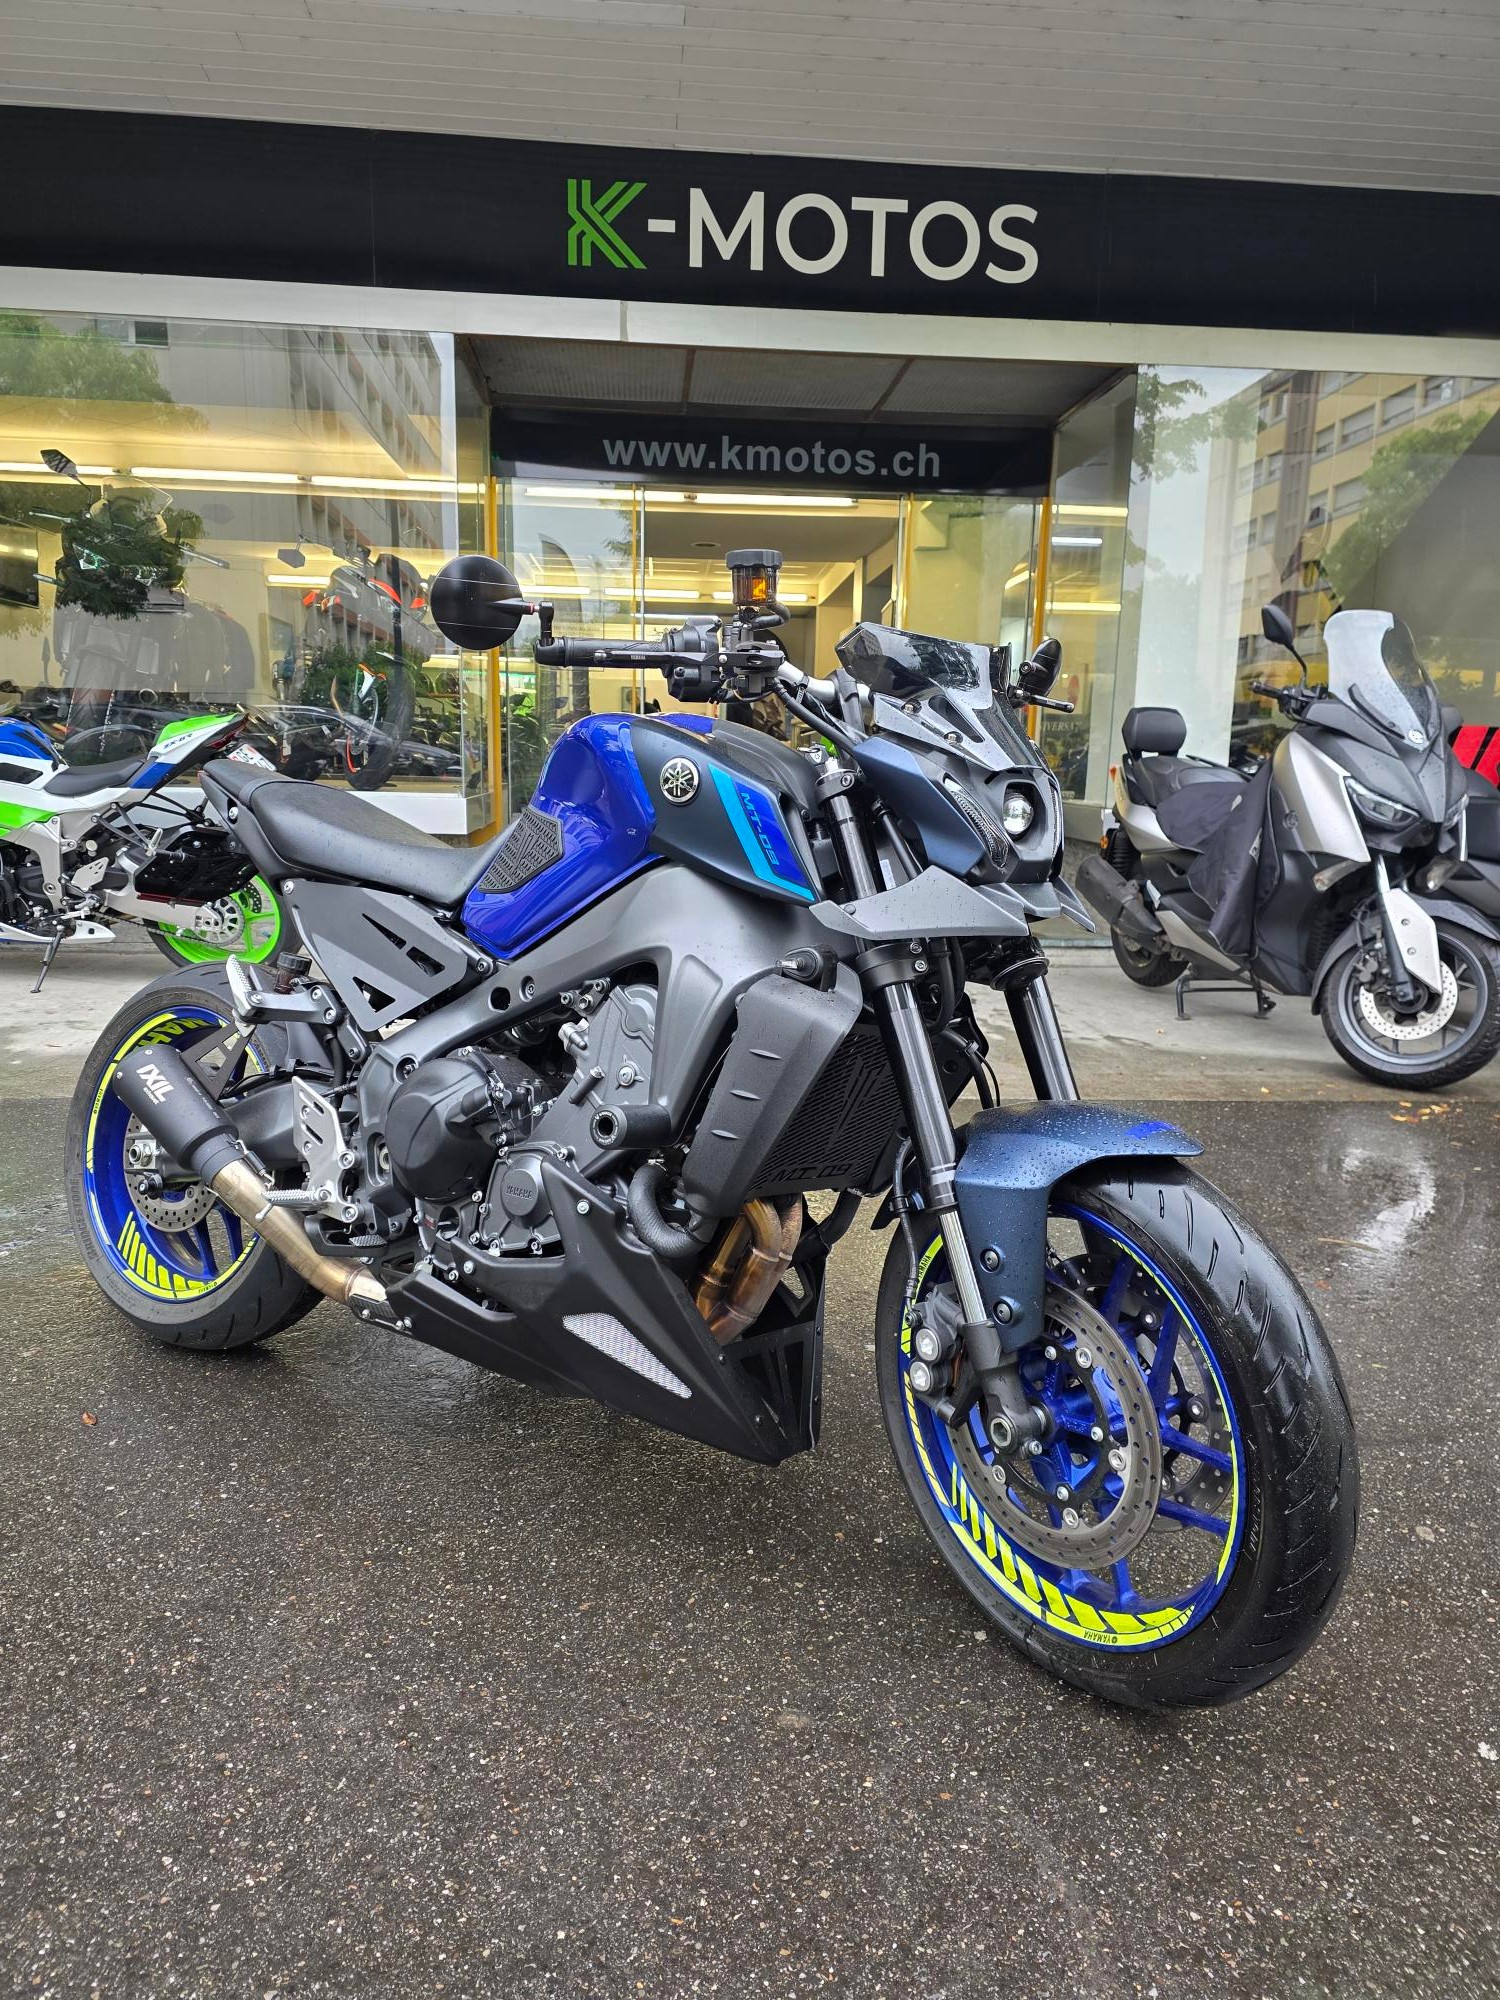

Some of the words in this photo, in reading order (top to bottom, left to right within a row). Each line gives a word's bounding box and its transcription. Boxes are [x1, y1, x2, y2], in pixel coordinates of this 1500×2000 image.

[566, 178, 1040, 285] K-MOTOS
[602, 435, 941, 478] www.kmotos.ch
[740, 792, 780, 866] MT-09
[136, 1063, 175, 1103] IXIL
[1083, 1629, 1111, 1644] YAMAHA
